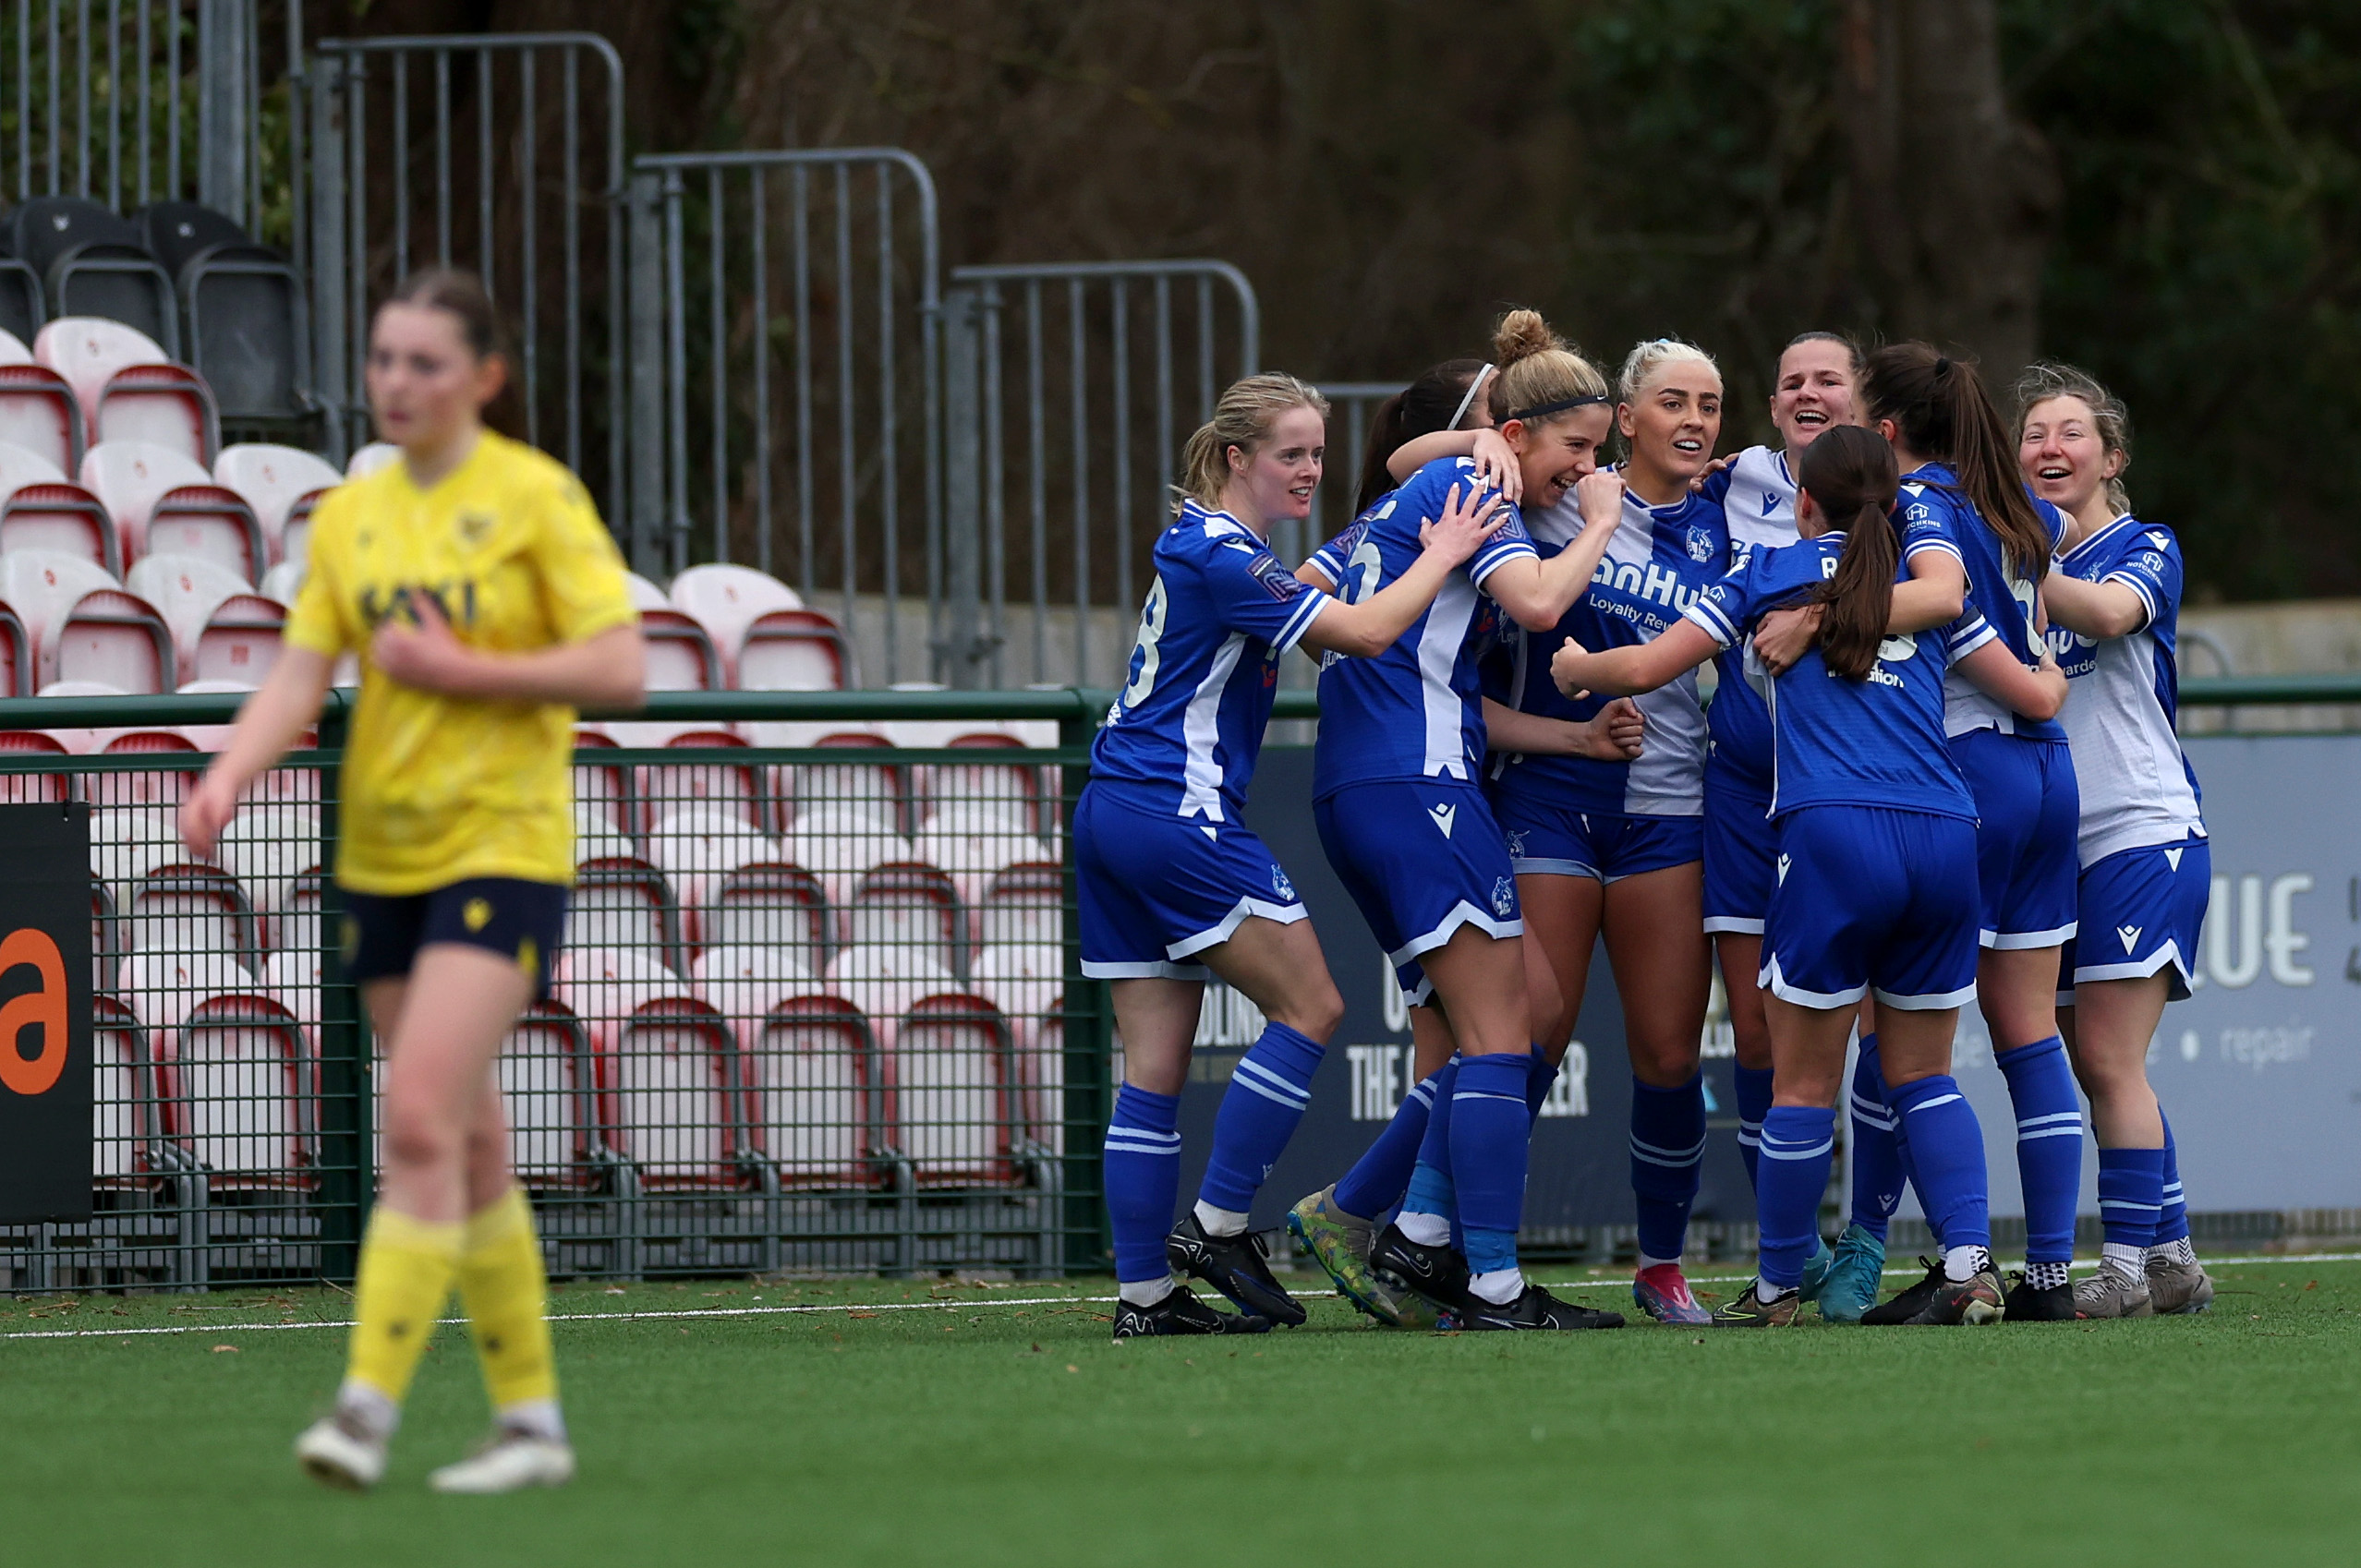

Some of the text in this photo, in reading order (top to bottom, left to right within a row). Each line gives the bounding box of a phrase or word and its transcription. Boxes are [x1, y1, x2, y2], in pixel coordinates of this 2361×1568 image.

[1589, 593, 1642, 621] Loyalty
[2193, 872, 2316, 989] UE
[2220, 1015, 2315, 1071] repair
[1346, 1044, 1402, 1121] THE
